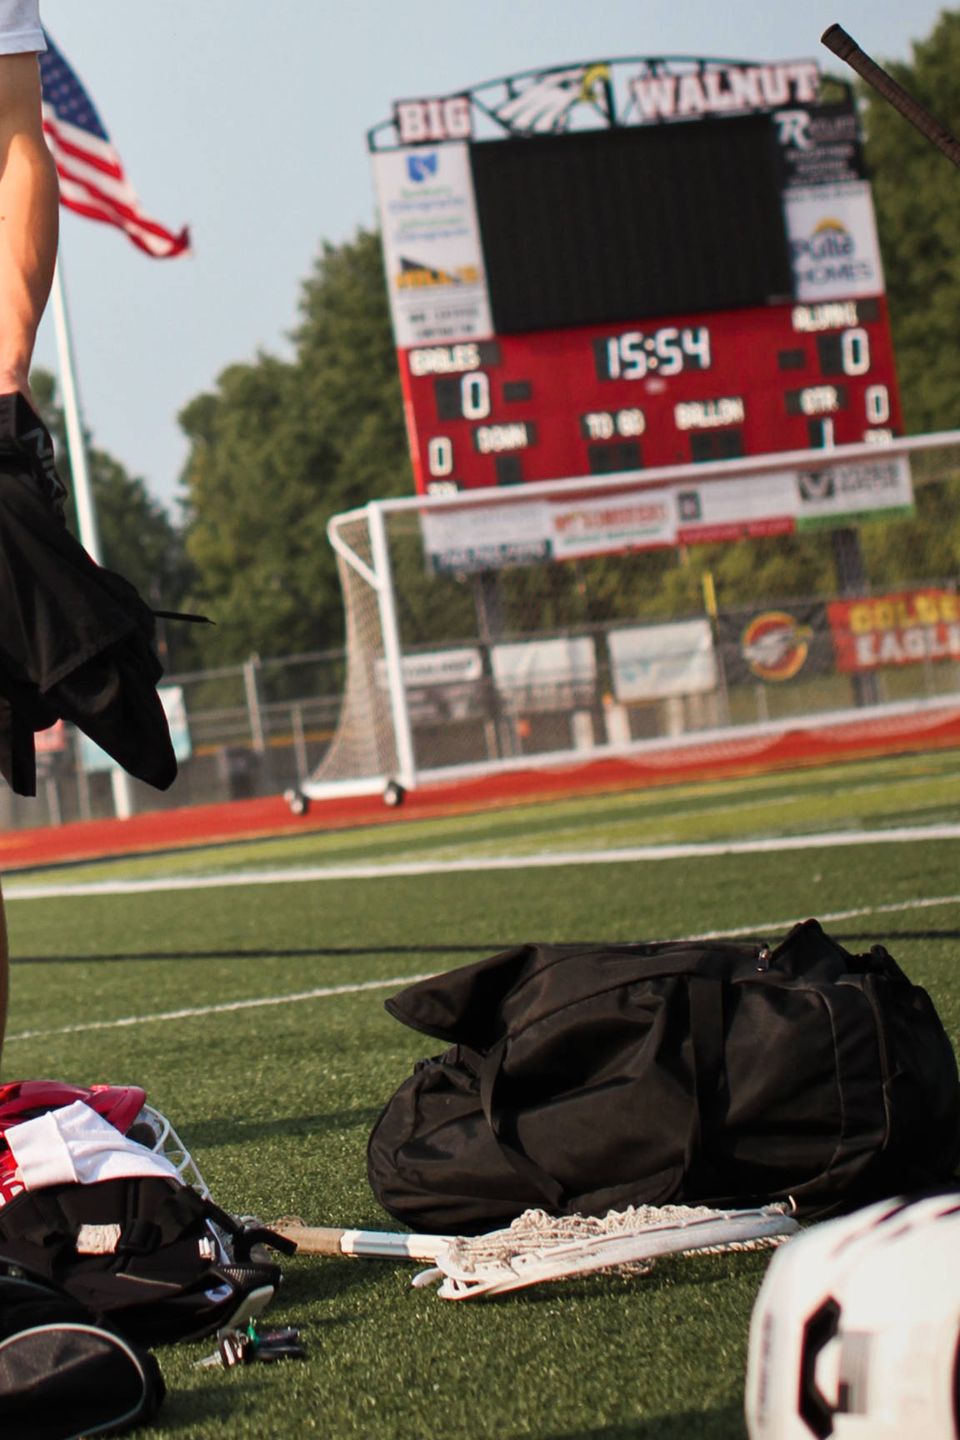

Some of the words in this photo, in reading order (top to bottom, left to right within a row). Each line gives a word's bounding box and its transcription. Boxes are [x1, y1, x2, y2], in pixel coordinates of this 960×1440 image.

[397, 95, 471, 143] BIG
[634, 62, 819, 118] WALNUT
[409, 343, 480, 376] EAGLES
[607, 326, 711, 380] 15:54
[842, 327, 870, 376] 0
[461, 371, 490, 421] 0
[865, 384, 890, 425] 0
[428, 436, 453, 477] 0
